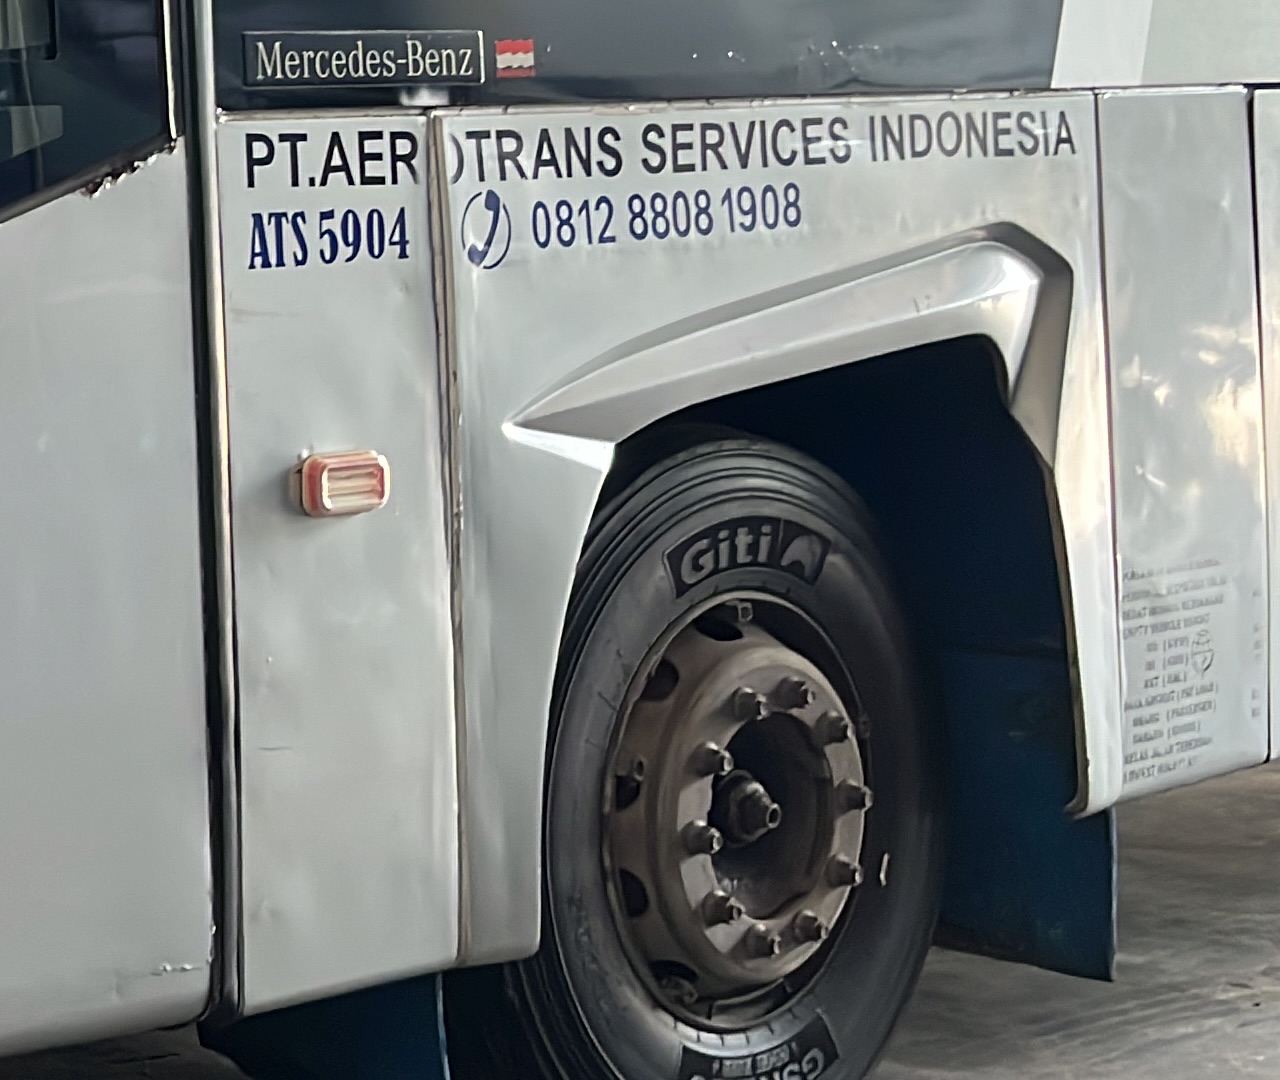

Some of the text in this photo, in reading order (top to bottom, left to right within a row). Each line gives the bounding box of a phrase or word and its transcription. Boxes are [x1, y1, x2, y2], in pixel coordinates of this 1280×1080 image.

[255, 38, 474, 81] Mercedes-Benz
[640, 116, 852, 174] SERVICES
[868, 110, 1077, 161] INDONESIA
[247, 206, 410, 270] ATS 5904
[532, 182, 802, 250] 0812 8808 1908
[680, 524, 773, 585] Giti
